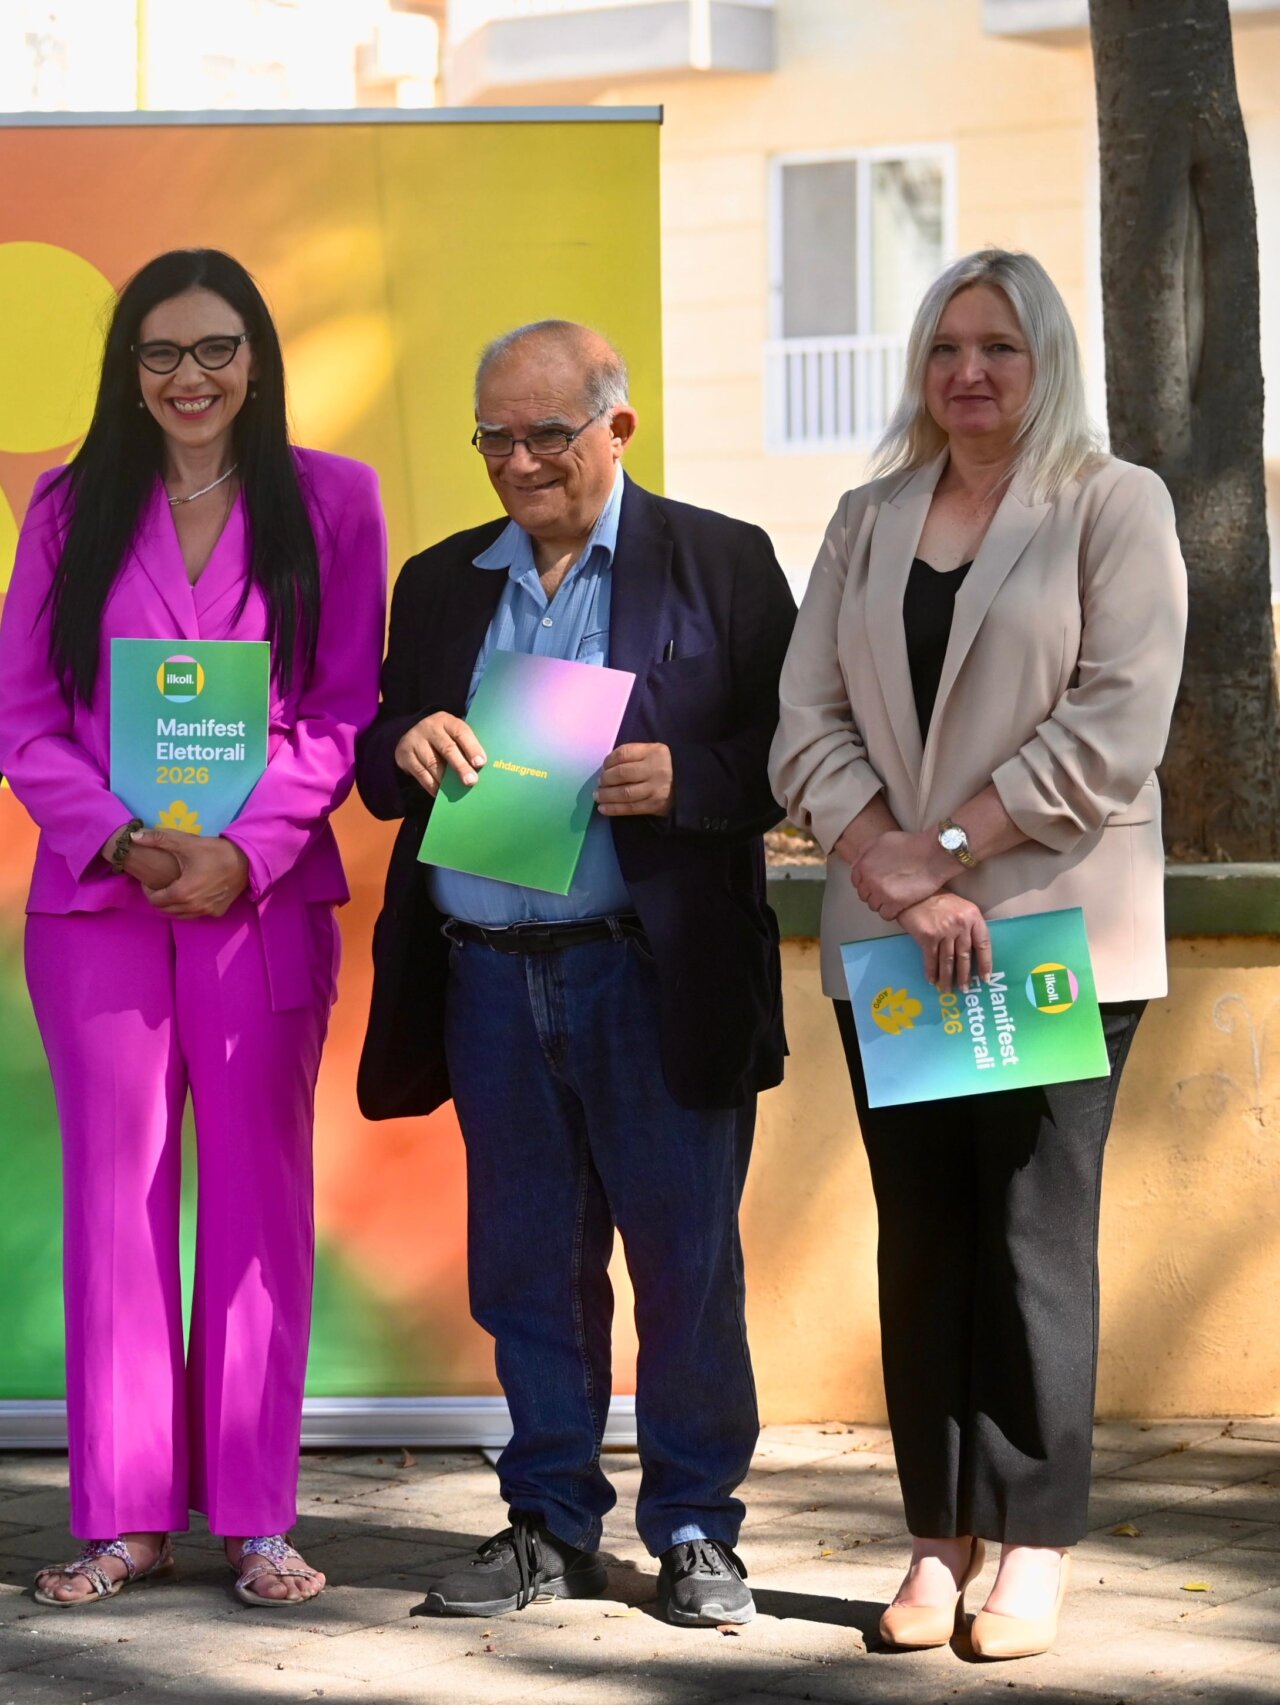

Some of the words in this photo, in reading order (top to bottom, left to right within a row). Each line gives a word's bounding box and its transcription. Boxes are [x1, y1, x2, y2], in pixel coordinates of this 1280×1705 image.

[167, 674, 195, 684] ilkoll.
[156, 718, 245, 737] Manifest
[156, 742, 245, 761] Elettorali
[156, 766, 210, 784] 2026
[1044, 973, 1060, 1004] ilkoll.
[987, 971, 1019, 1066] Manifest
